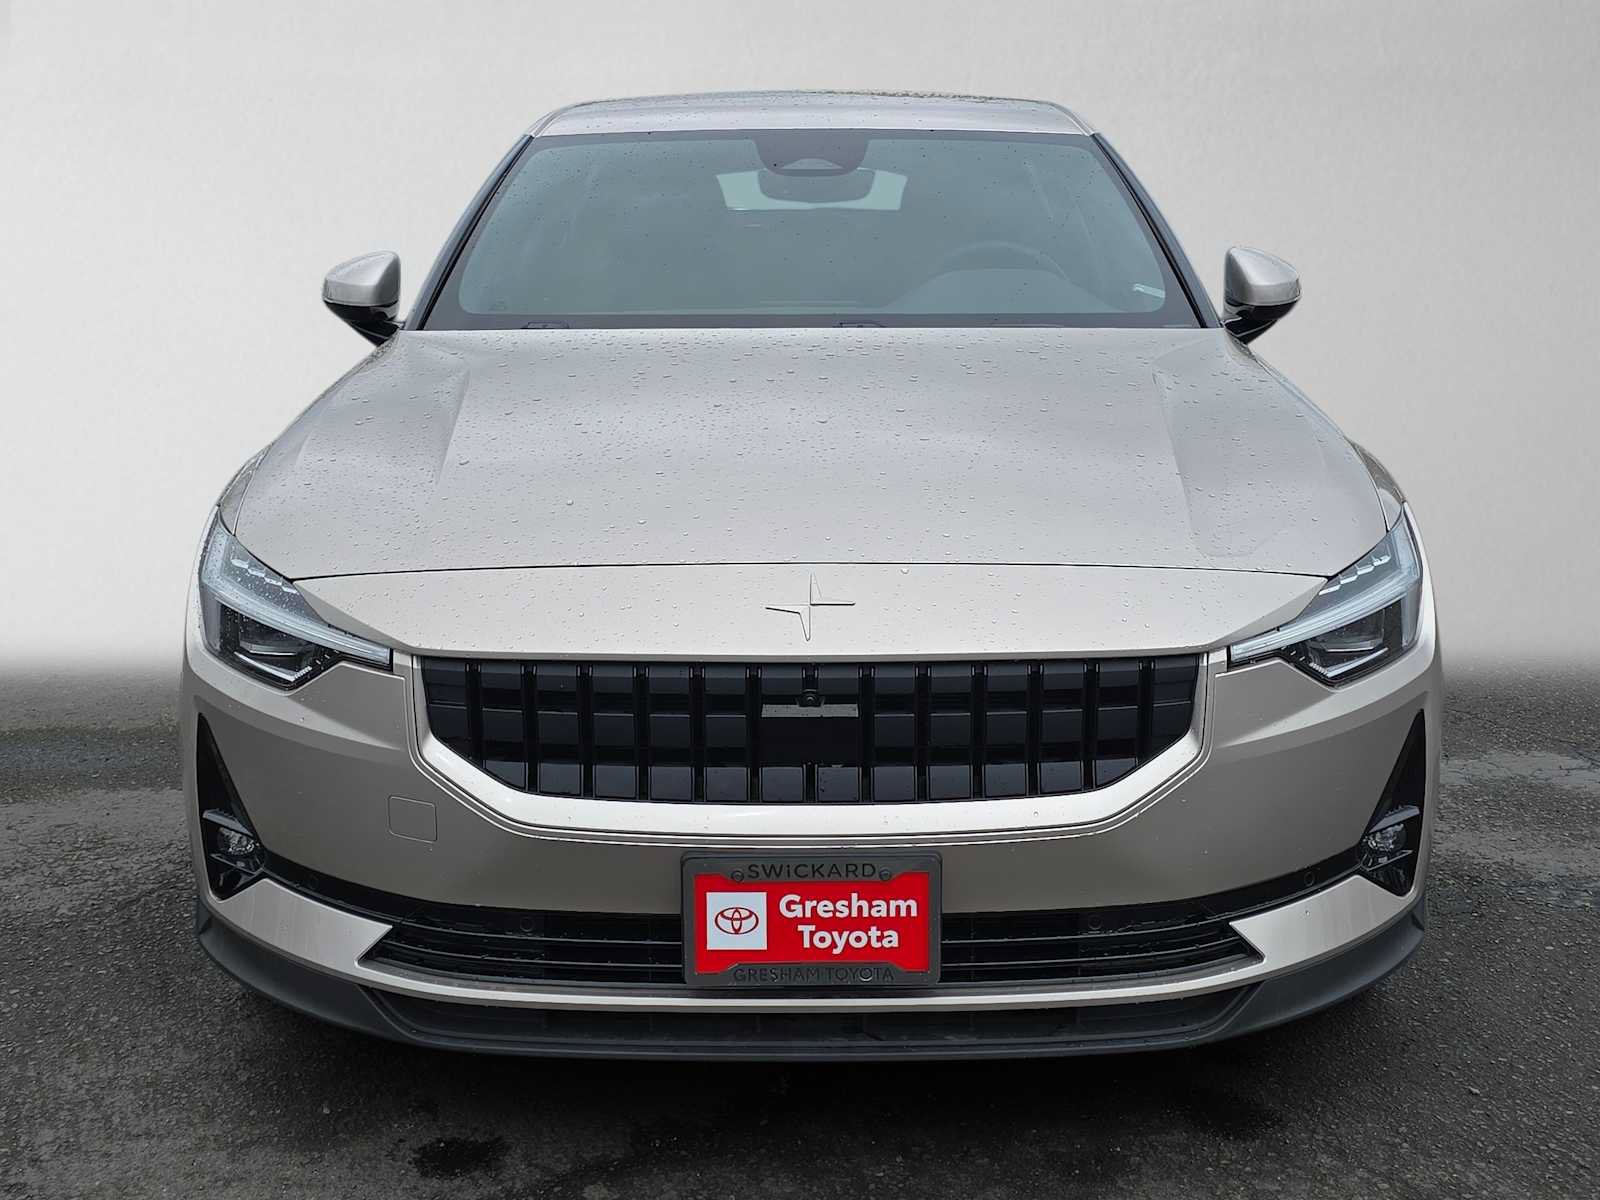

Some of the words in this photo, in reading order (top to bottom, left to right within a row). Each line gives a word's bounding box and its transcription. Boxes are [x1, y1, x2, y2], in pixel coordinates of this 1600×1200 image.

[779, 893, 917, 918] Gresham
[797, 925, 899, 954] Toyota
[733, 967, 820, 982] GRESHAM
[826, 966, 894, 981] TOYOTA
